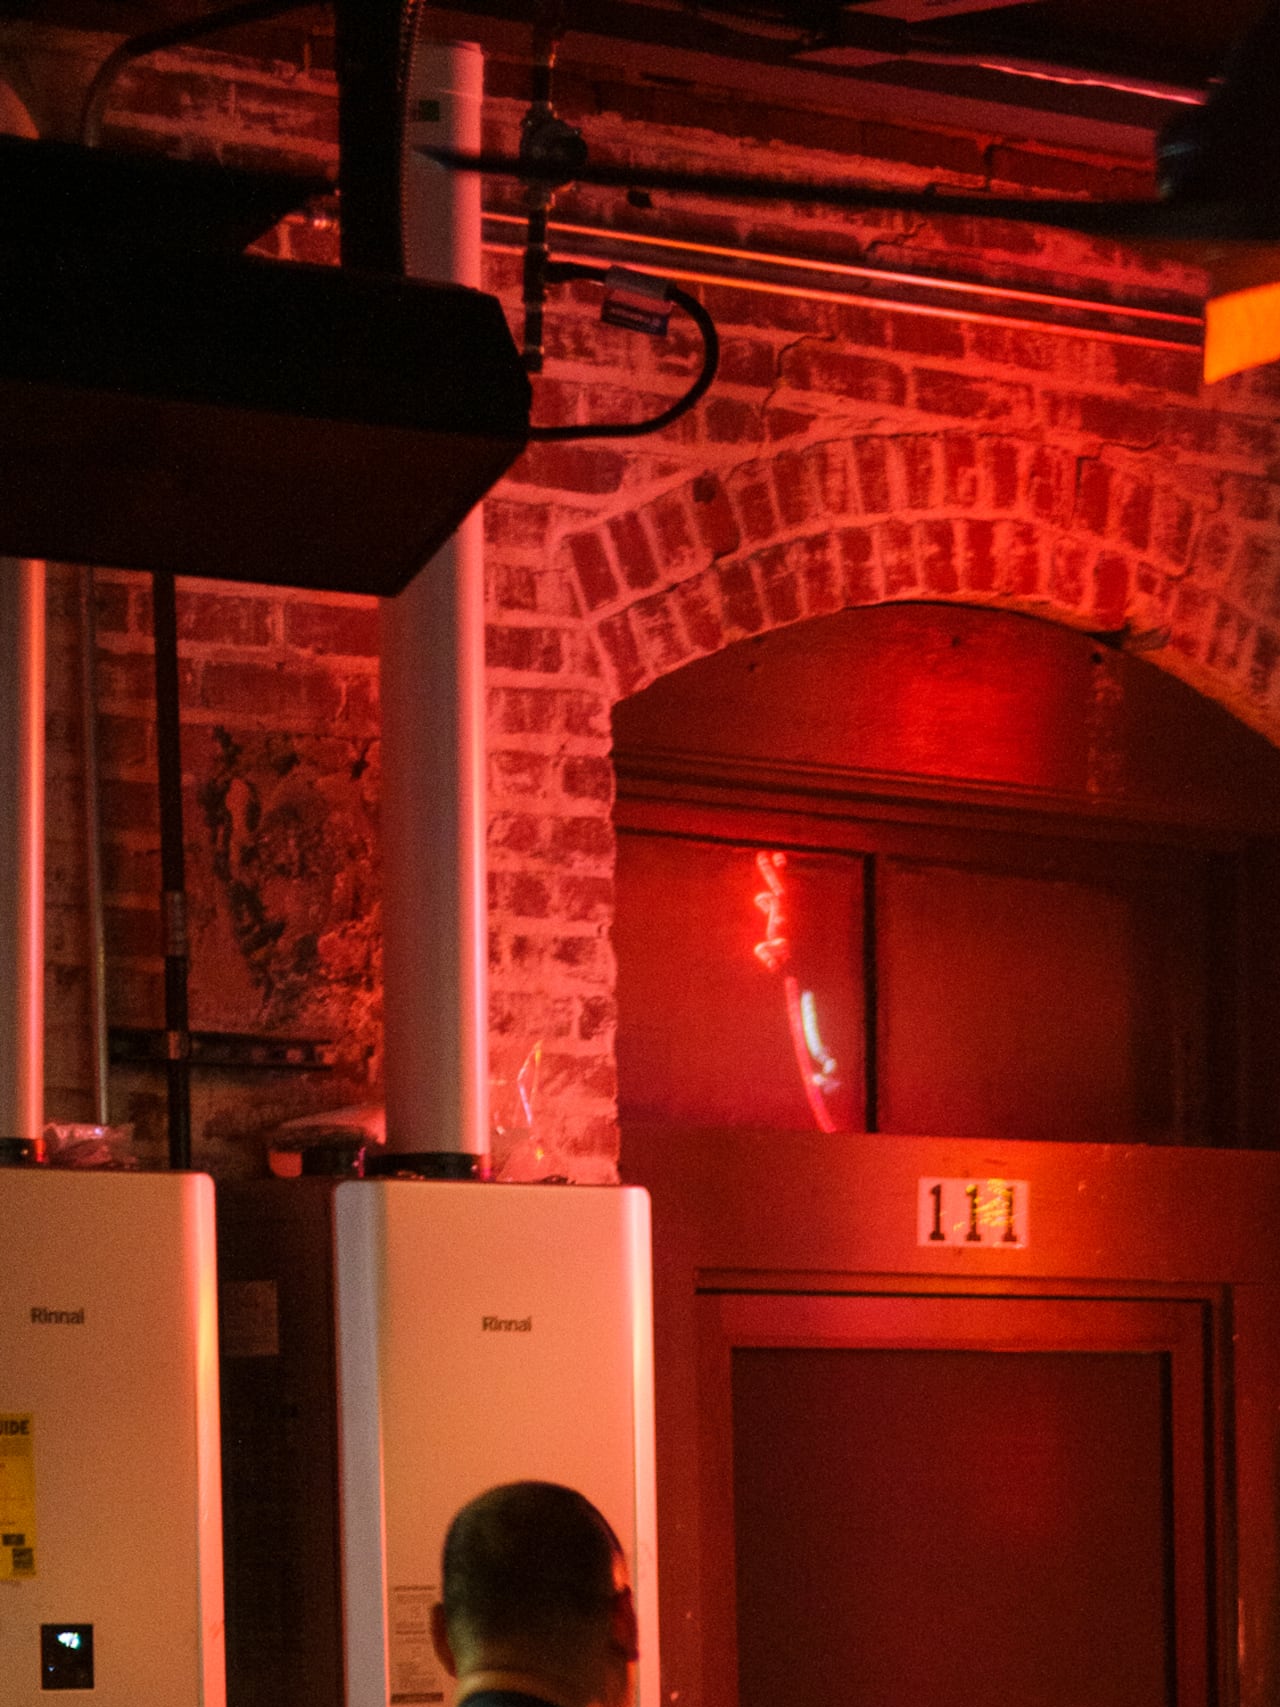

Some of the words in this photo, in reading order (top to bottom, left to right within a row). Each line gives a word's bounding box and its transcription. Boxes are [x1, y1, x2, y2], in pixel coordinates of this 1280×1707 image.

[929, 1184, 1018, 1241] 111
[31, 1307, 84, 1324] Rinnai
[481, 1316, 532, 1332] Rinnai
